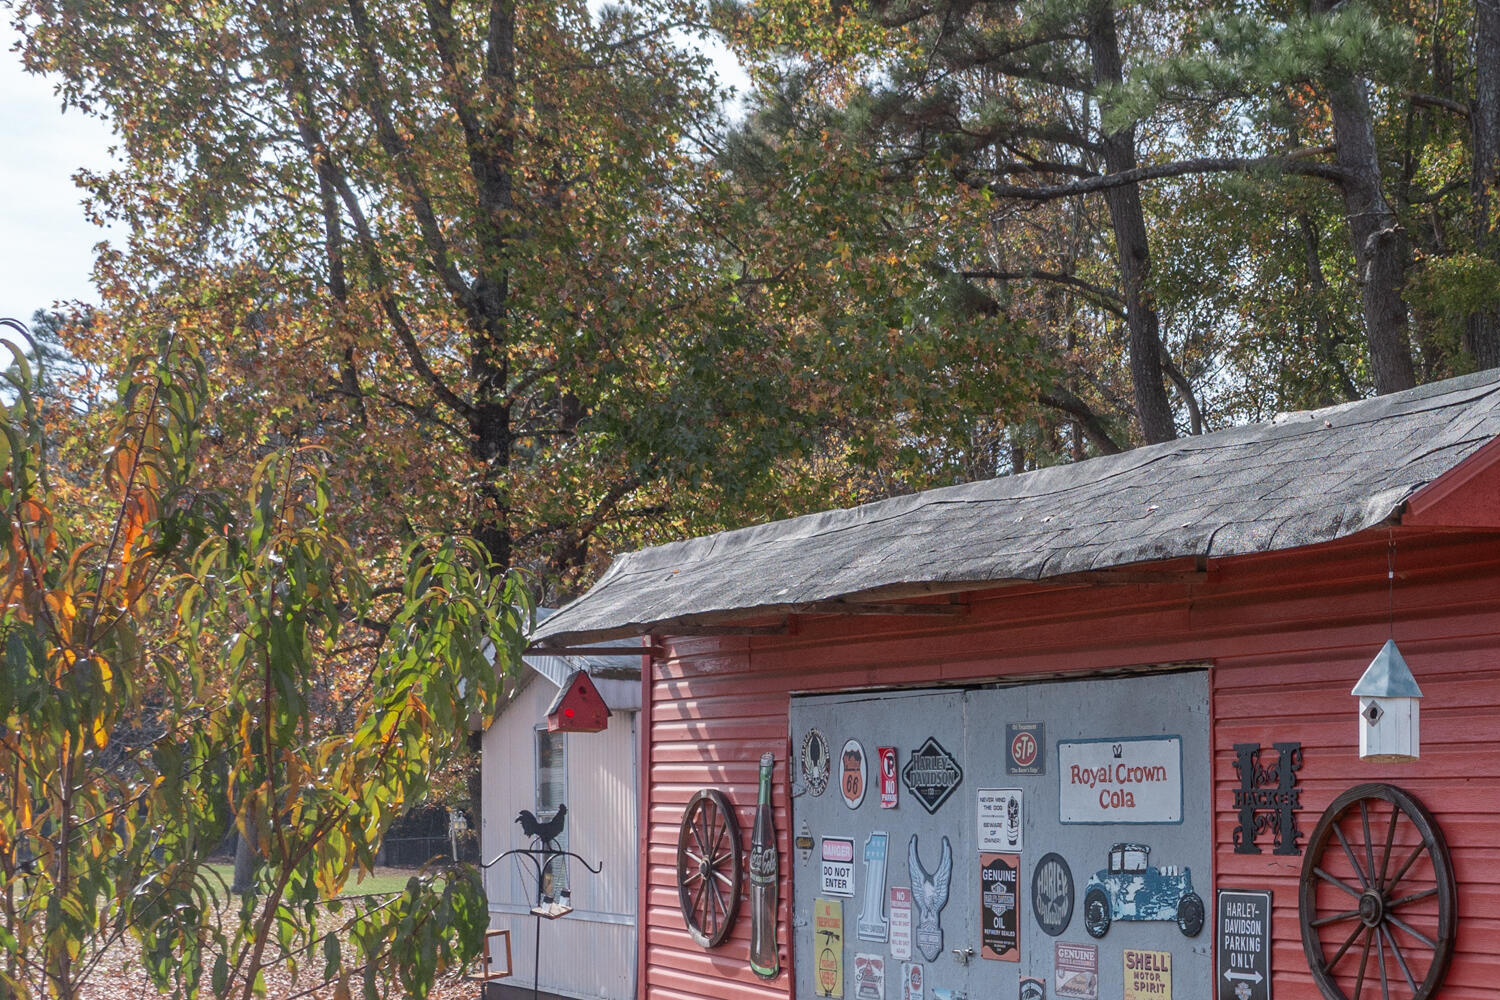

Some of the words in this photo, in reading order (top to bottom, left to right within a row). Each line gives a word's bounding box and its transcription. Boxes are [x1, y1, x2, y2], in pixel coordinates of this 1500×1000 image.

[1015, 736, 1034, 760] STP
[912, 753, 952, 770] HARLEY-
[910, 770, 955, 787] DAVIDSON
[1070, 764, 1112, 789] Royal
[1115, 763, 1168, 785] Crown
[846, 774, 859, 795] 66
[885, 780, 896, 794] NO
[1099, 789, 1136, 809] Cola
[1232, 789, 1303, 809] HACKER
[823, 843, 852, 858] DANGER
[823, 866, 833, 876] DO
[834, 867, 850, 878] NOT
[982, 869, 1016, 881] GENUINE
[825, 878, 847, 888] ENTER
[896, 892, 906, 900] NO
[1226, 902, 1260, 918] HARLEY-
[993, 917, 1006, 928] OIL
[1224, 919, 1261, 935] DAVIDSON
[1224, 935, 1261, 953] PARKING
[1058, 948, 1095, 961] GENUINE
[1126, 951, 1169, 973] SHELL
[1230, 952, 1255, 969] ONLY
[1133, 971, 1161, 982] MOTOR
[1133, 982, 1166, 994] SPIRIT
